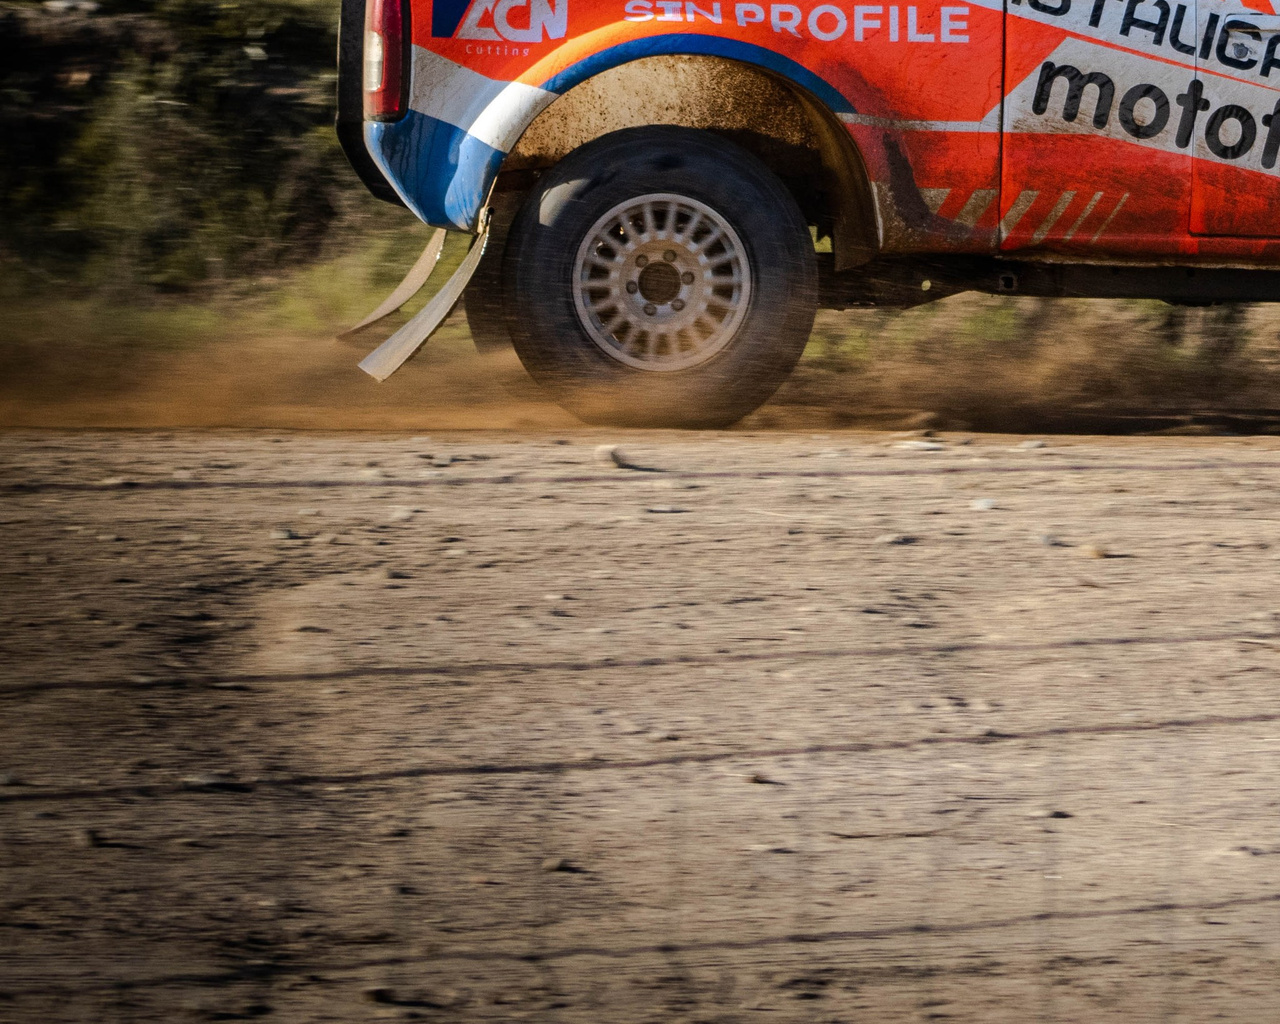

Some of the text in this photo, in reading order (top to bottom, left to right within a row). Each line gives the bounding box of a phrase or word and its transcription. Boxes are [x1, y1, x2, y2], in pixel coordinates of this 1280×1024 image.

[623, 0, 970, 44] SIN PROFILE
[465, 44, 530, 57] Cutting
